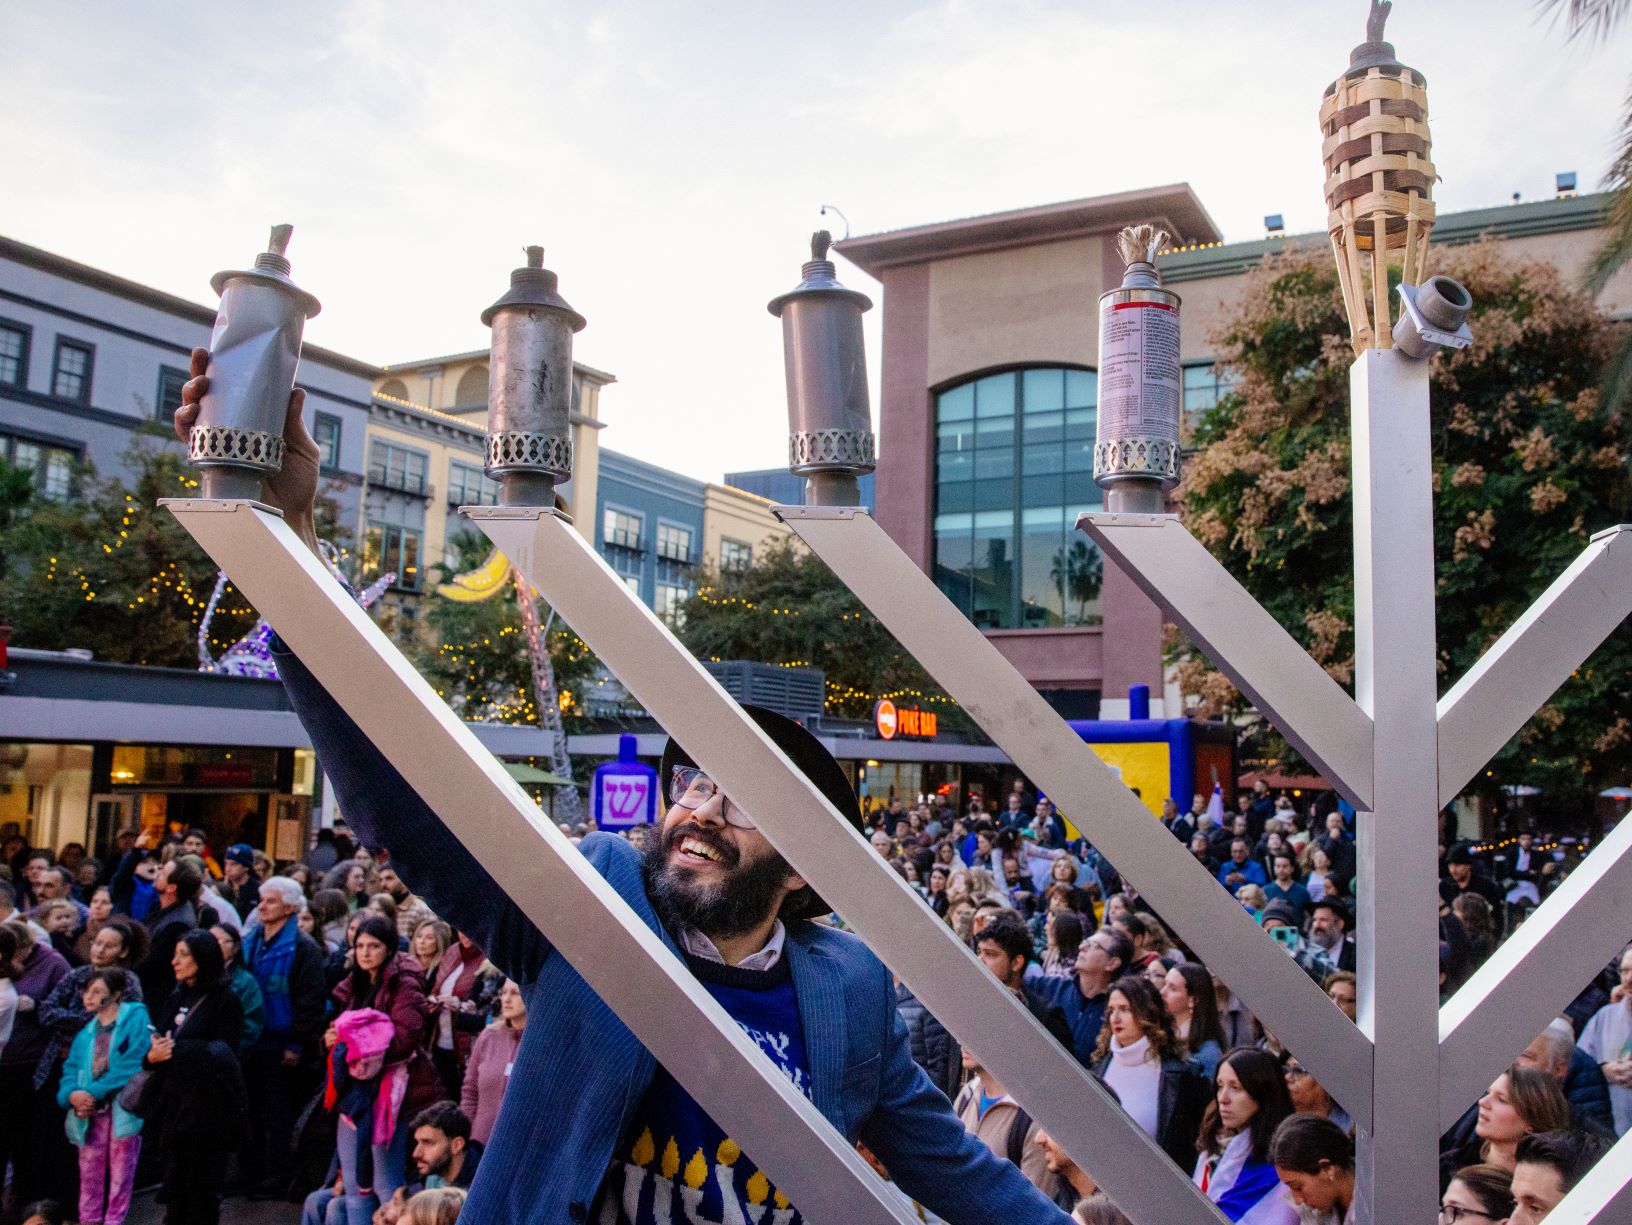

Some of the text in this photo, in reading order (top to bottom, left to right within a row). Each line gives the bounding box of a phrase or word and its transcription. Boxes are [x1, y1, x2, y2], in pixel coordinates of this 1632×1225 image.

[898, 704, 919, 735] POKÉ
[920, 711, 937, 736] BAR
[605, 781, 647, 818] ש
